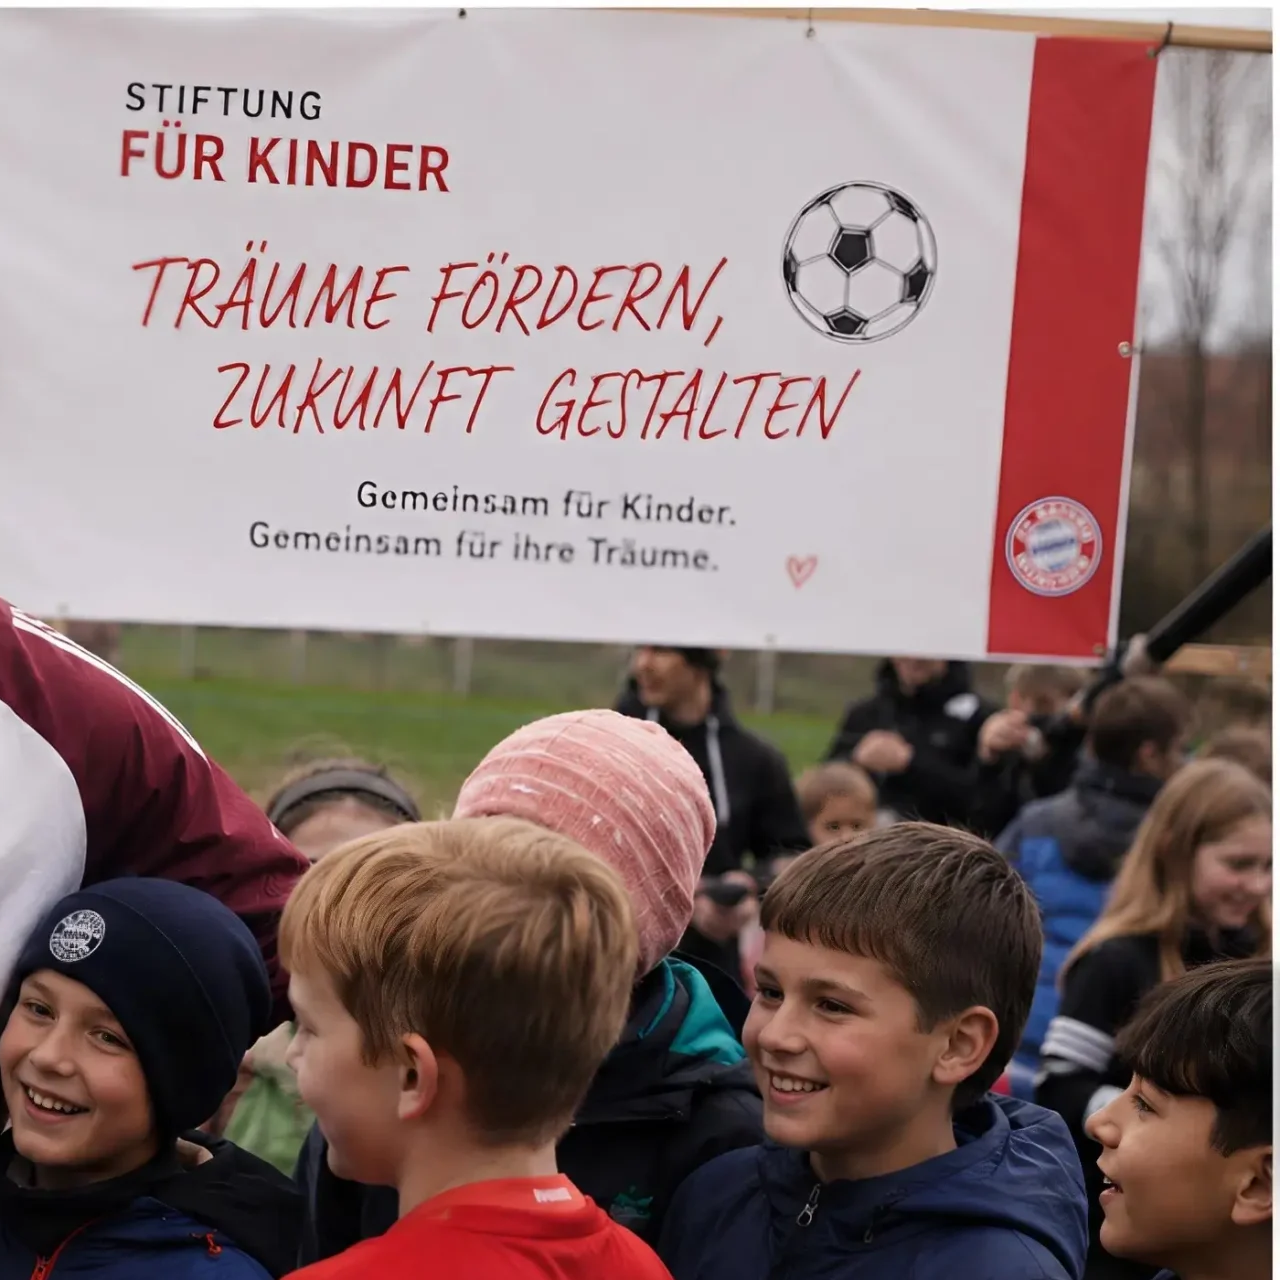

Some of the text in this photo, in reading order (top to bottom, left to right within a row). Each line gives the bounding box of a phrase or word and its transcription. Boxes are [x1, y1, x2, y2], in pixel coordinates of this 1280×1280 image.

[126, 83, 321, 120] STIFTUNG
[121, 120, 449, 192] FÜR KINDER
[132, 241, 727, 346] TRÄUME FÖRDERN,
[213, 358, 861, 440] ZUKUNFT GESTALTEN
[358, 481, 735, 525] Gemeinsam für Kinder.
[250, 522, 717, 570] Gemeinsam für ihre Träume.
